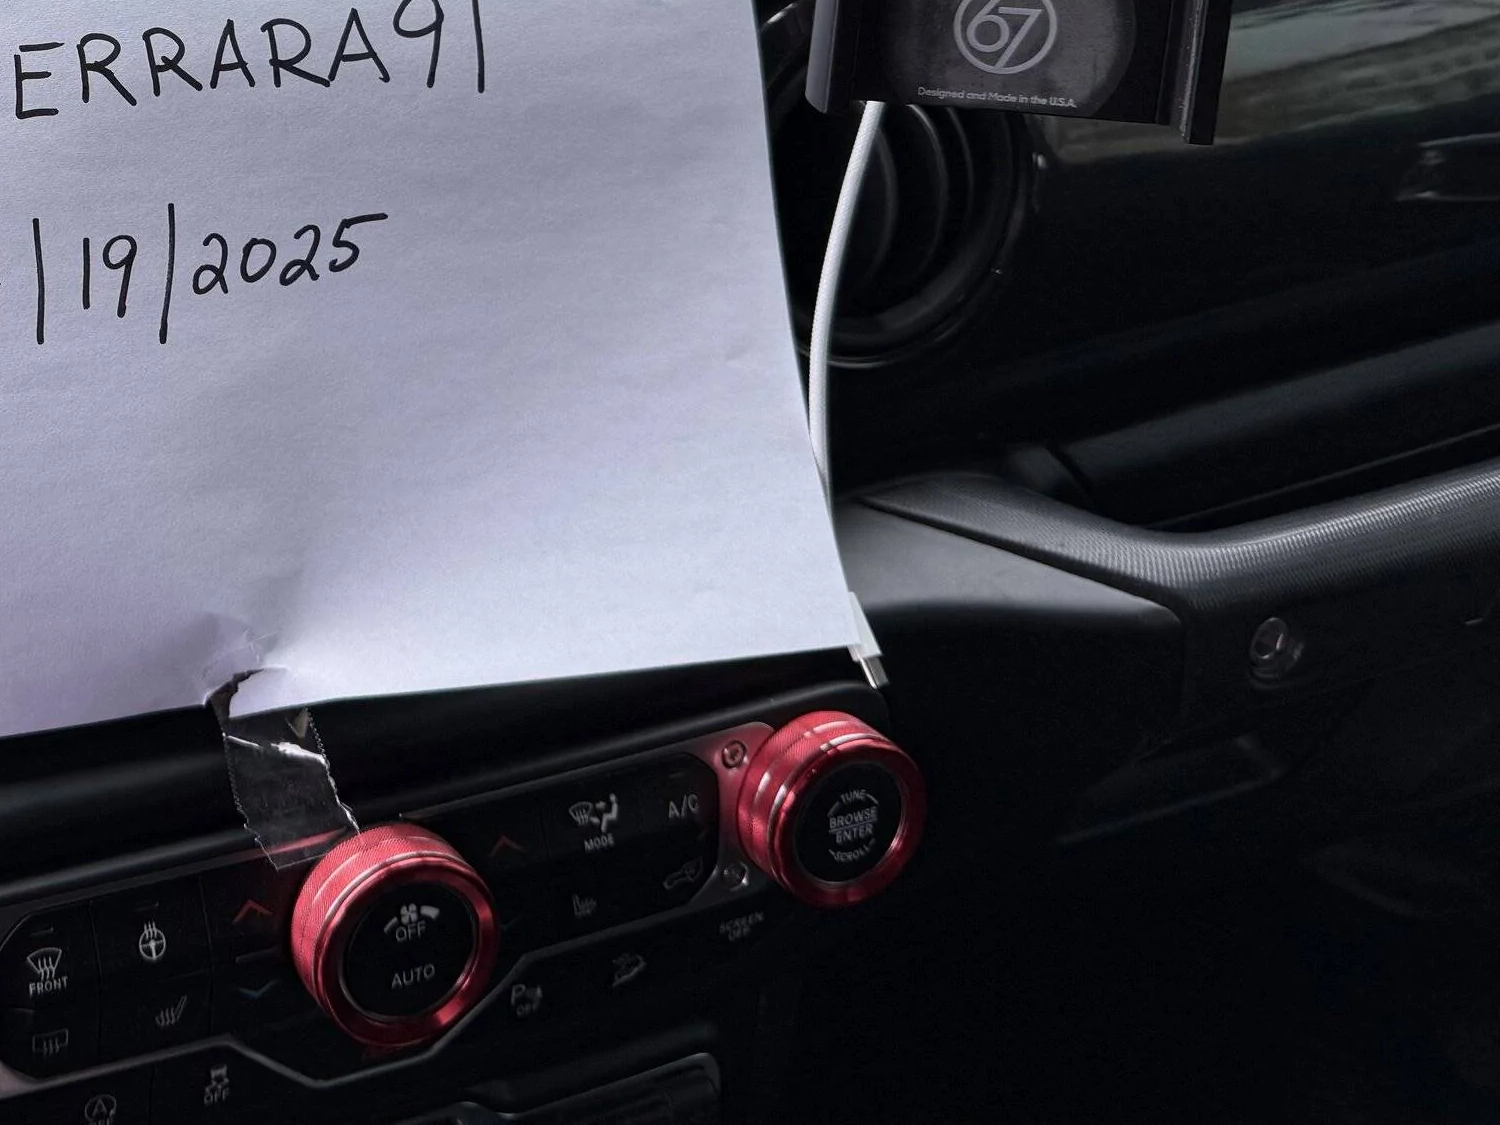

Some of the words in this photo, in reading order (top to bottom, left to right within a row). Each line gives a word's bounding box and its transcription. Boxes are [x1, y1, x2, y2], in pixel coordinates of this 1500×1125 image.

[917, 86, 965, 100] Designed
[966, 91, 987, 101] and
[988, 92, 1018, 103] Made
[1018, 94, 1029, 104] in
[1030, 95, 1047, 105] the
[668, 794, 699, 822] A/C
[829, 806, 877, 829] BROWSE
[584, 832, 615, 854] MODE
[835, 823, 874, 844] ENTER
[394, 920, 427, 943] OFF
[28, 975, 69, 998] FRONT
[391, 963, 436, 989] AUTO
